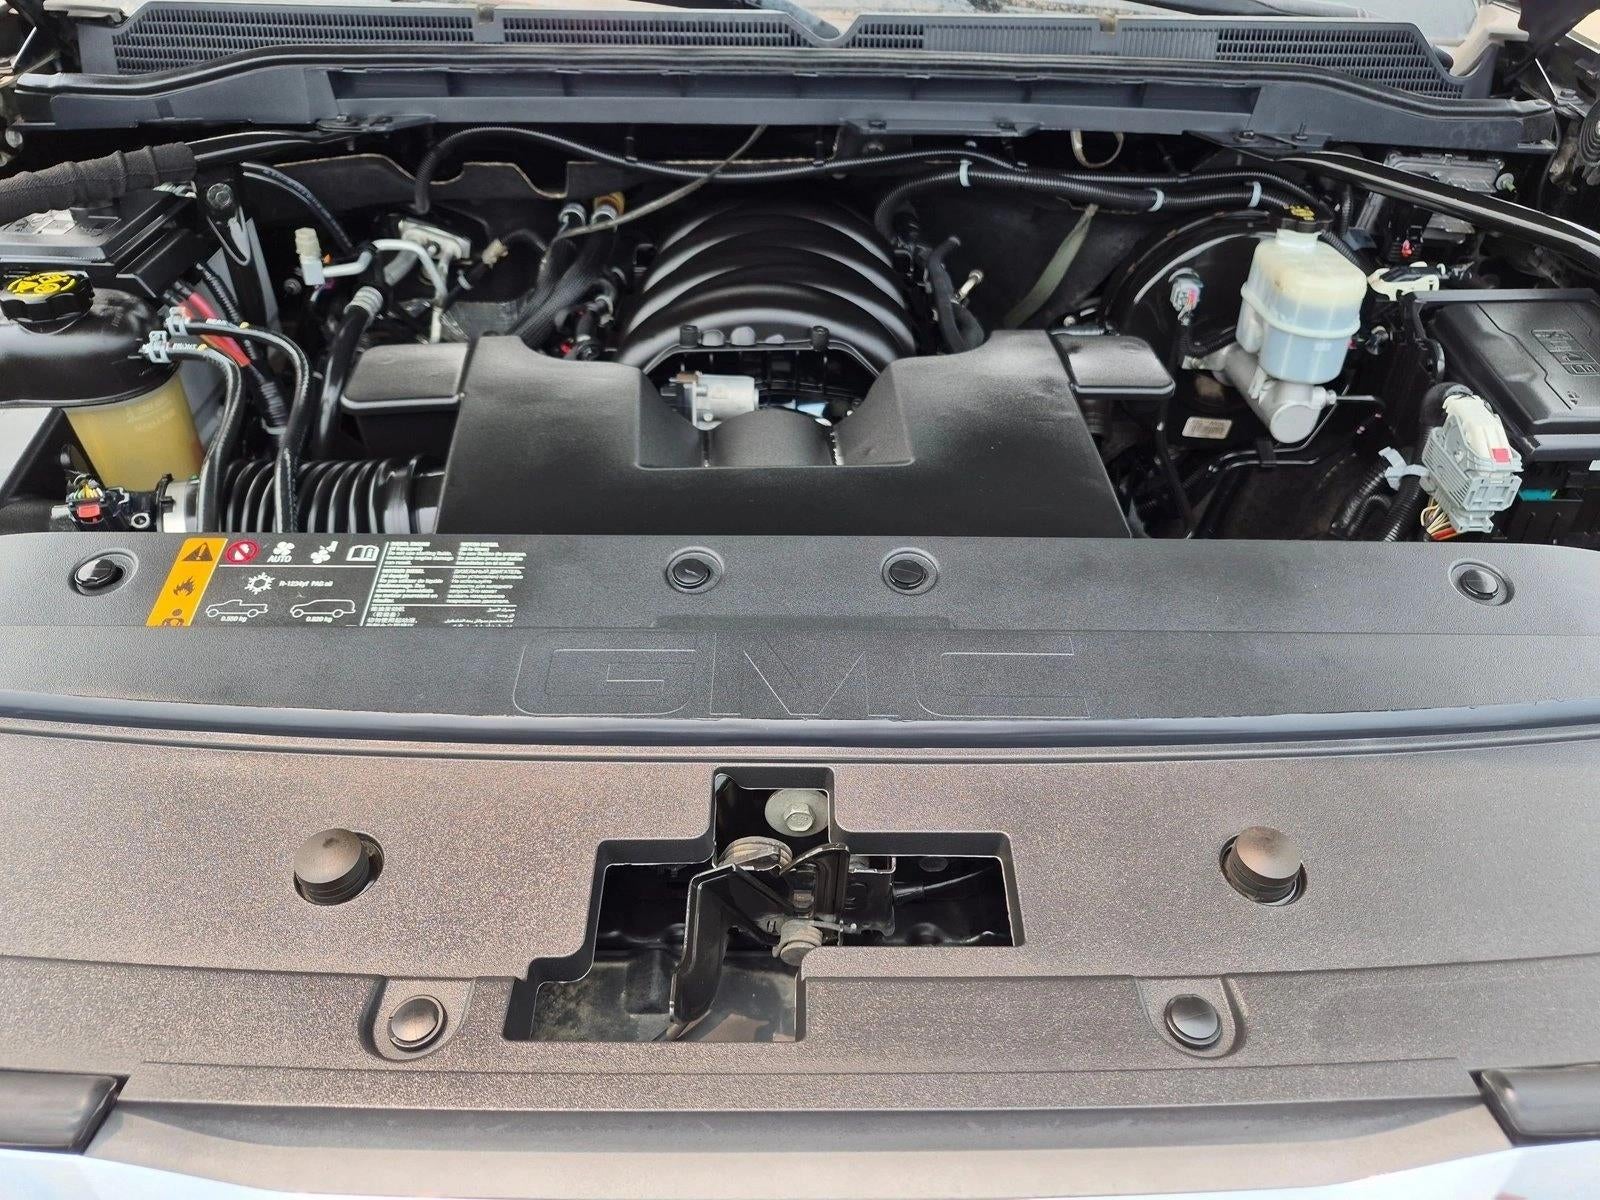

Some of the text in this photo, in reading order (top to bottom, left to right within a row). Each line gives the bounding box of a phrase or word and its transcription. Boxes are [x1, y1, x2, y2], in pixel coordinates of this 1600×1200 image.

[267, 554, 293, 563] AUTO
[238, 615, 248, 623] kg
[324, 616, 334, 624] kg
[512, 632, 1092, 719] GMC
